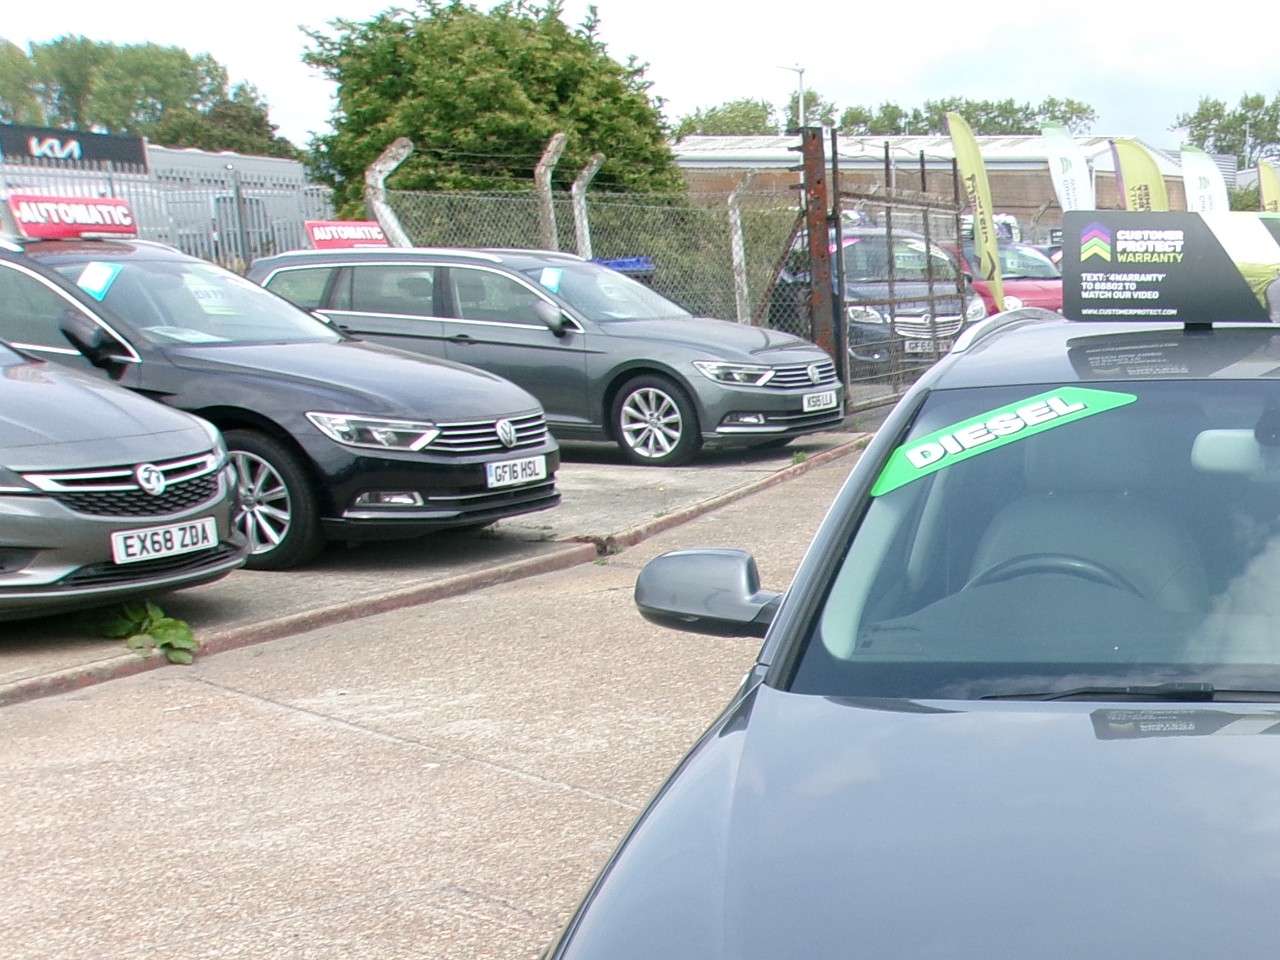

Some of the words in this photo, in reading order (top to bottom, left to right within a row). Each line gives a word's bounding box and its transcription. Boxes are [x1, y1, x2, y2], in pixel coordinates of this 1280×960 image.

[18, 201, 132, 226] AUTOMATIC
[312, 227, 384, 241] AUTOMATIC
[1116, 230, 1184, 240] CUSTOMER
[1116, 241, 1184, 252] PROTECT
[1116, 253, 1184, 263] WARRANTY
[1124, 283, 1137, 291] TO
[1081, 291, 1112, 299] WATCH
[1113, 291, 1132, 299] OUR
[1132, 291, 1160, 299] VIDEO
[905, 396, 1087, 469] DIESEL
[123, 530, 175, 558] EX68
